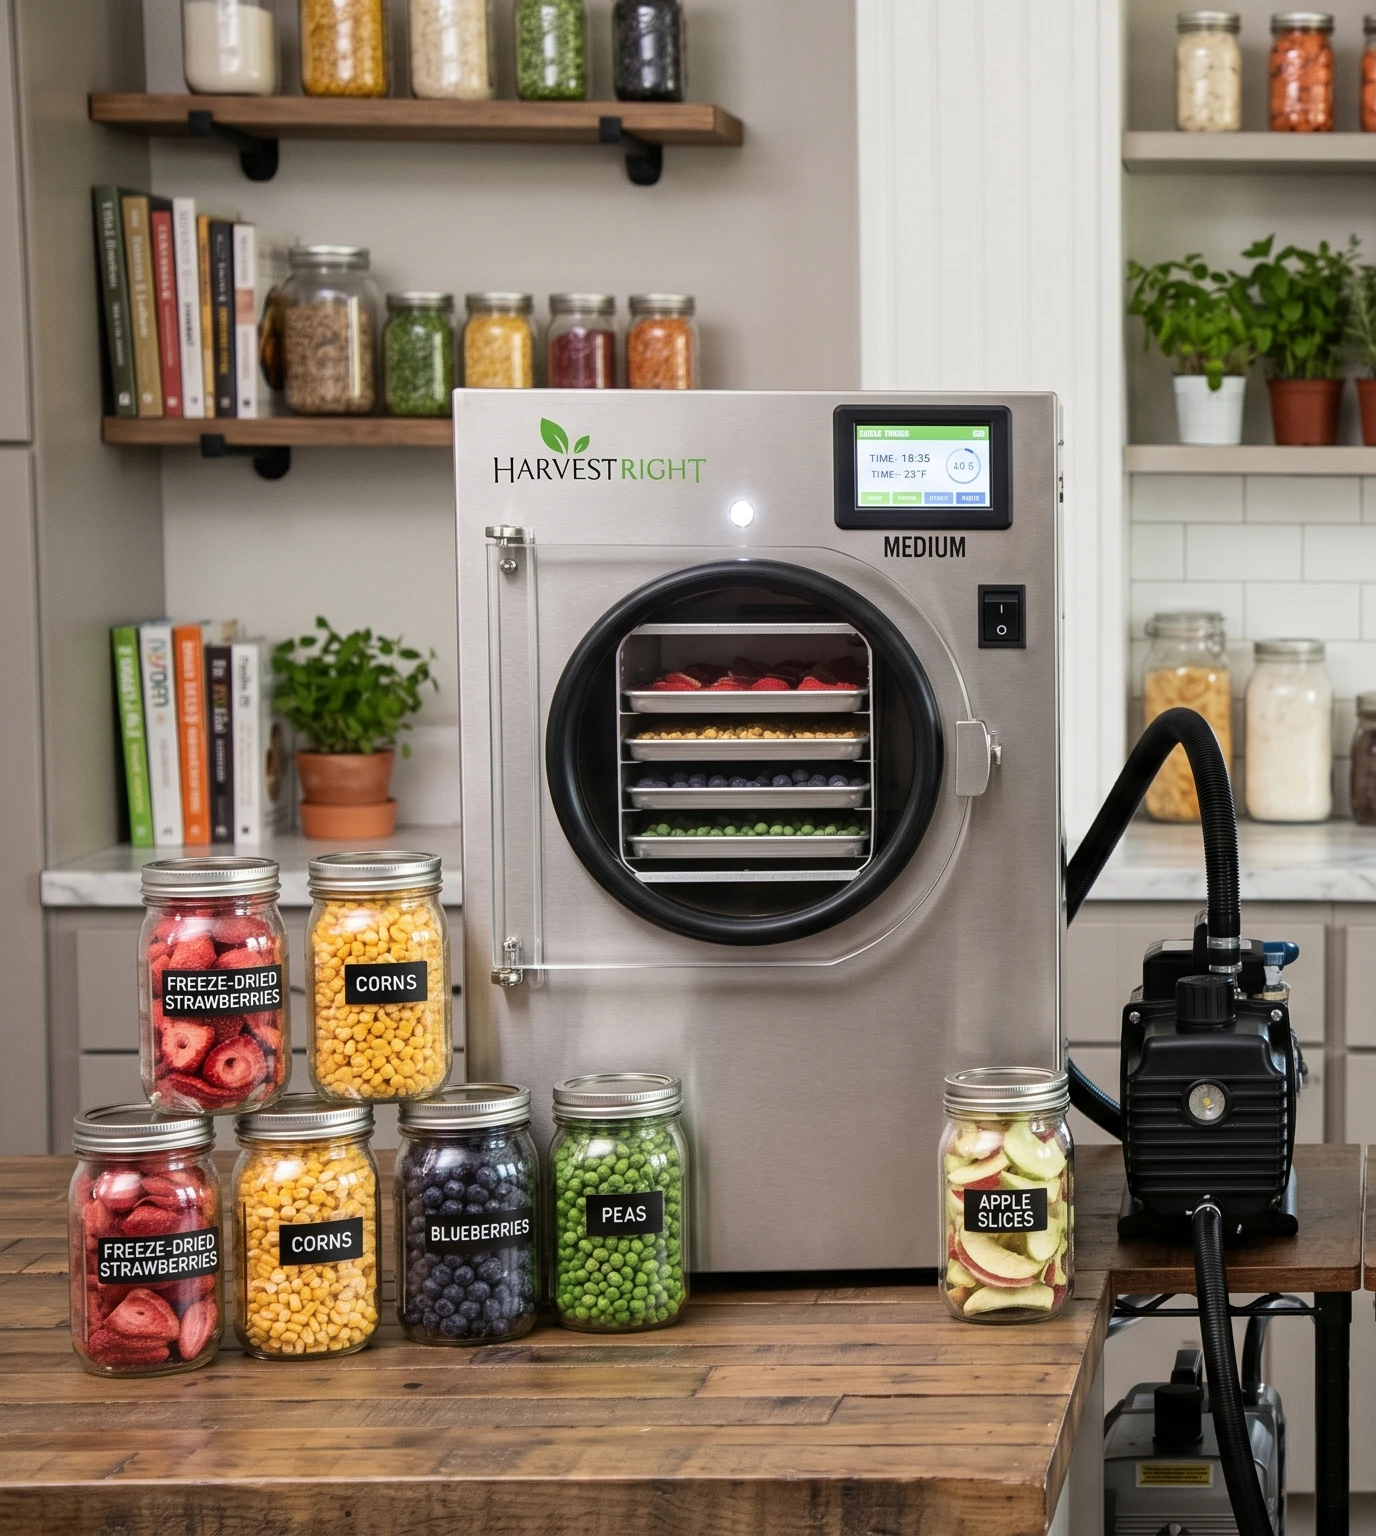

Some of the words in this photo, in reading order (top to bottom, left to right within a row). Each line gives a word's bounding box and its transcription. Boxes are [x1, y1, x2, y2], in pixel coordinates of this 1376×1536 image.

[901, 453, 931, 463] 18:35
[883, 536, 967, 558] MEDIUM
[167, 971, 278, 992] FREEZE-DRIED
[355, 974, 418, 993] CORNS
[165, 988, 281, 1011] STRAWBERRIES
[978, 1193, 1032, 1210] APPLE
[601, 1205, 648, 1224] PEAS
[977, 1210, 1035, 1228] SLICES
[430, 1218, 531, 1243] BLUEBERRIES
[103, 1233, 216, 1259] FREEZE-DRIED
[291, 1231, 353, 1254] CORNS
[99, 1250, 219, 1278] STRAWBERRIES
